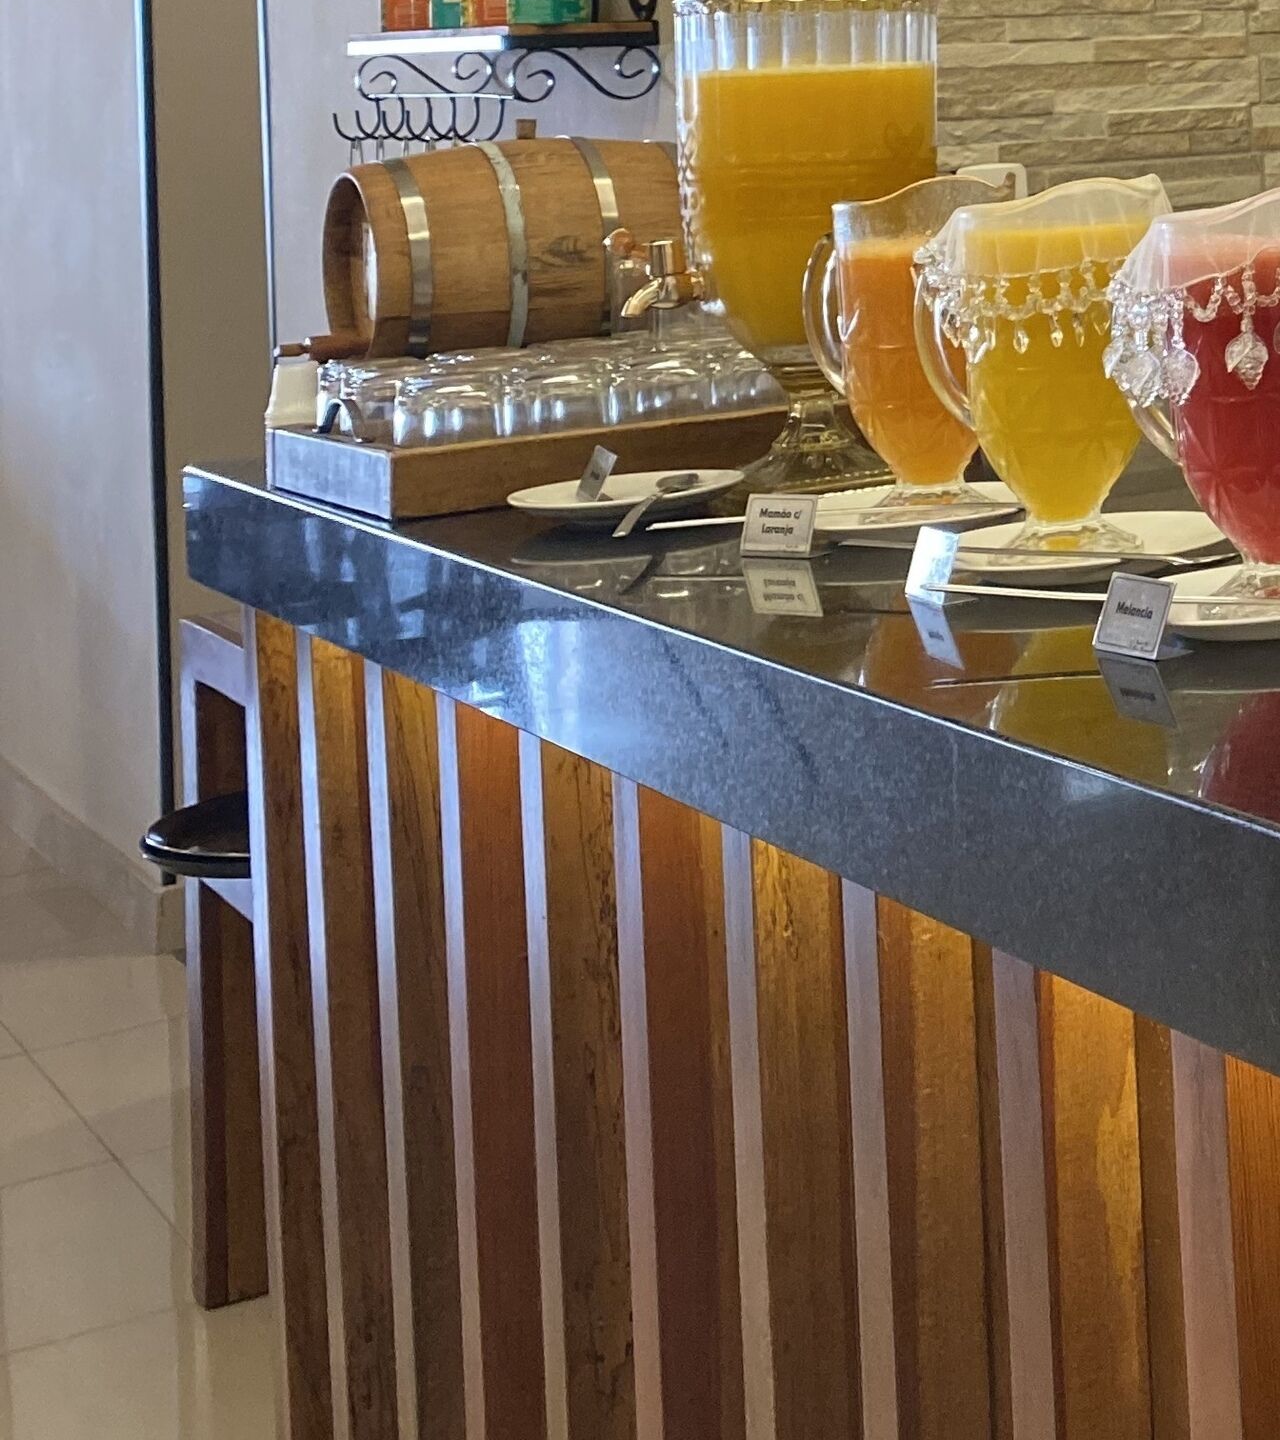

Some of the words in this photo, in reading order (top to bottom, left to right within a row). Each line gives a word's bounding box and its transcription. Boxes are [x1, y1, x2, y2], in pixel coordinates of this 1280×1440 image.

[759, 507, 792, 519] Mamão
[761, 523, 794, 536] Laranja
[1115, 601, 1154, 620] Melancia
